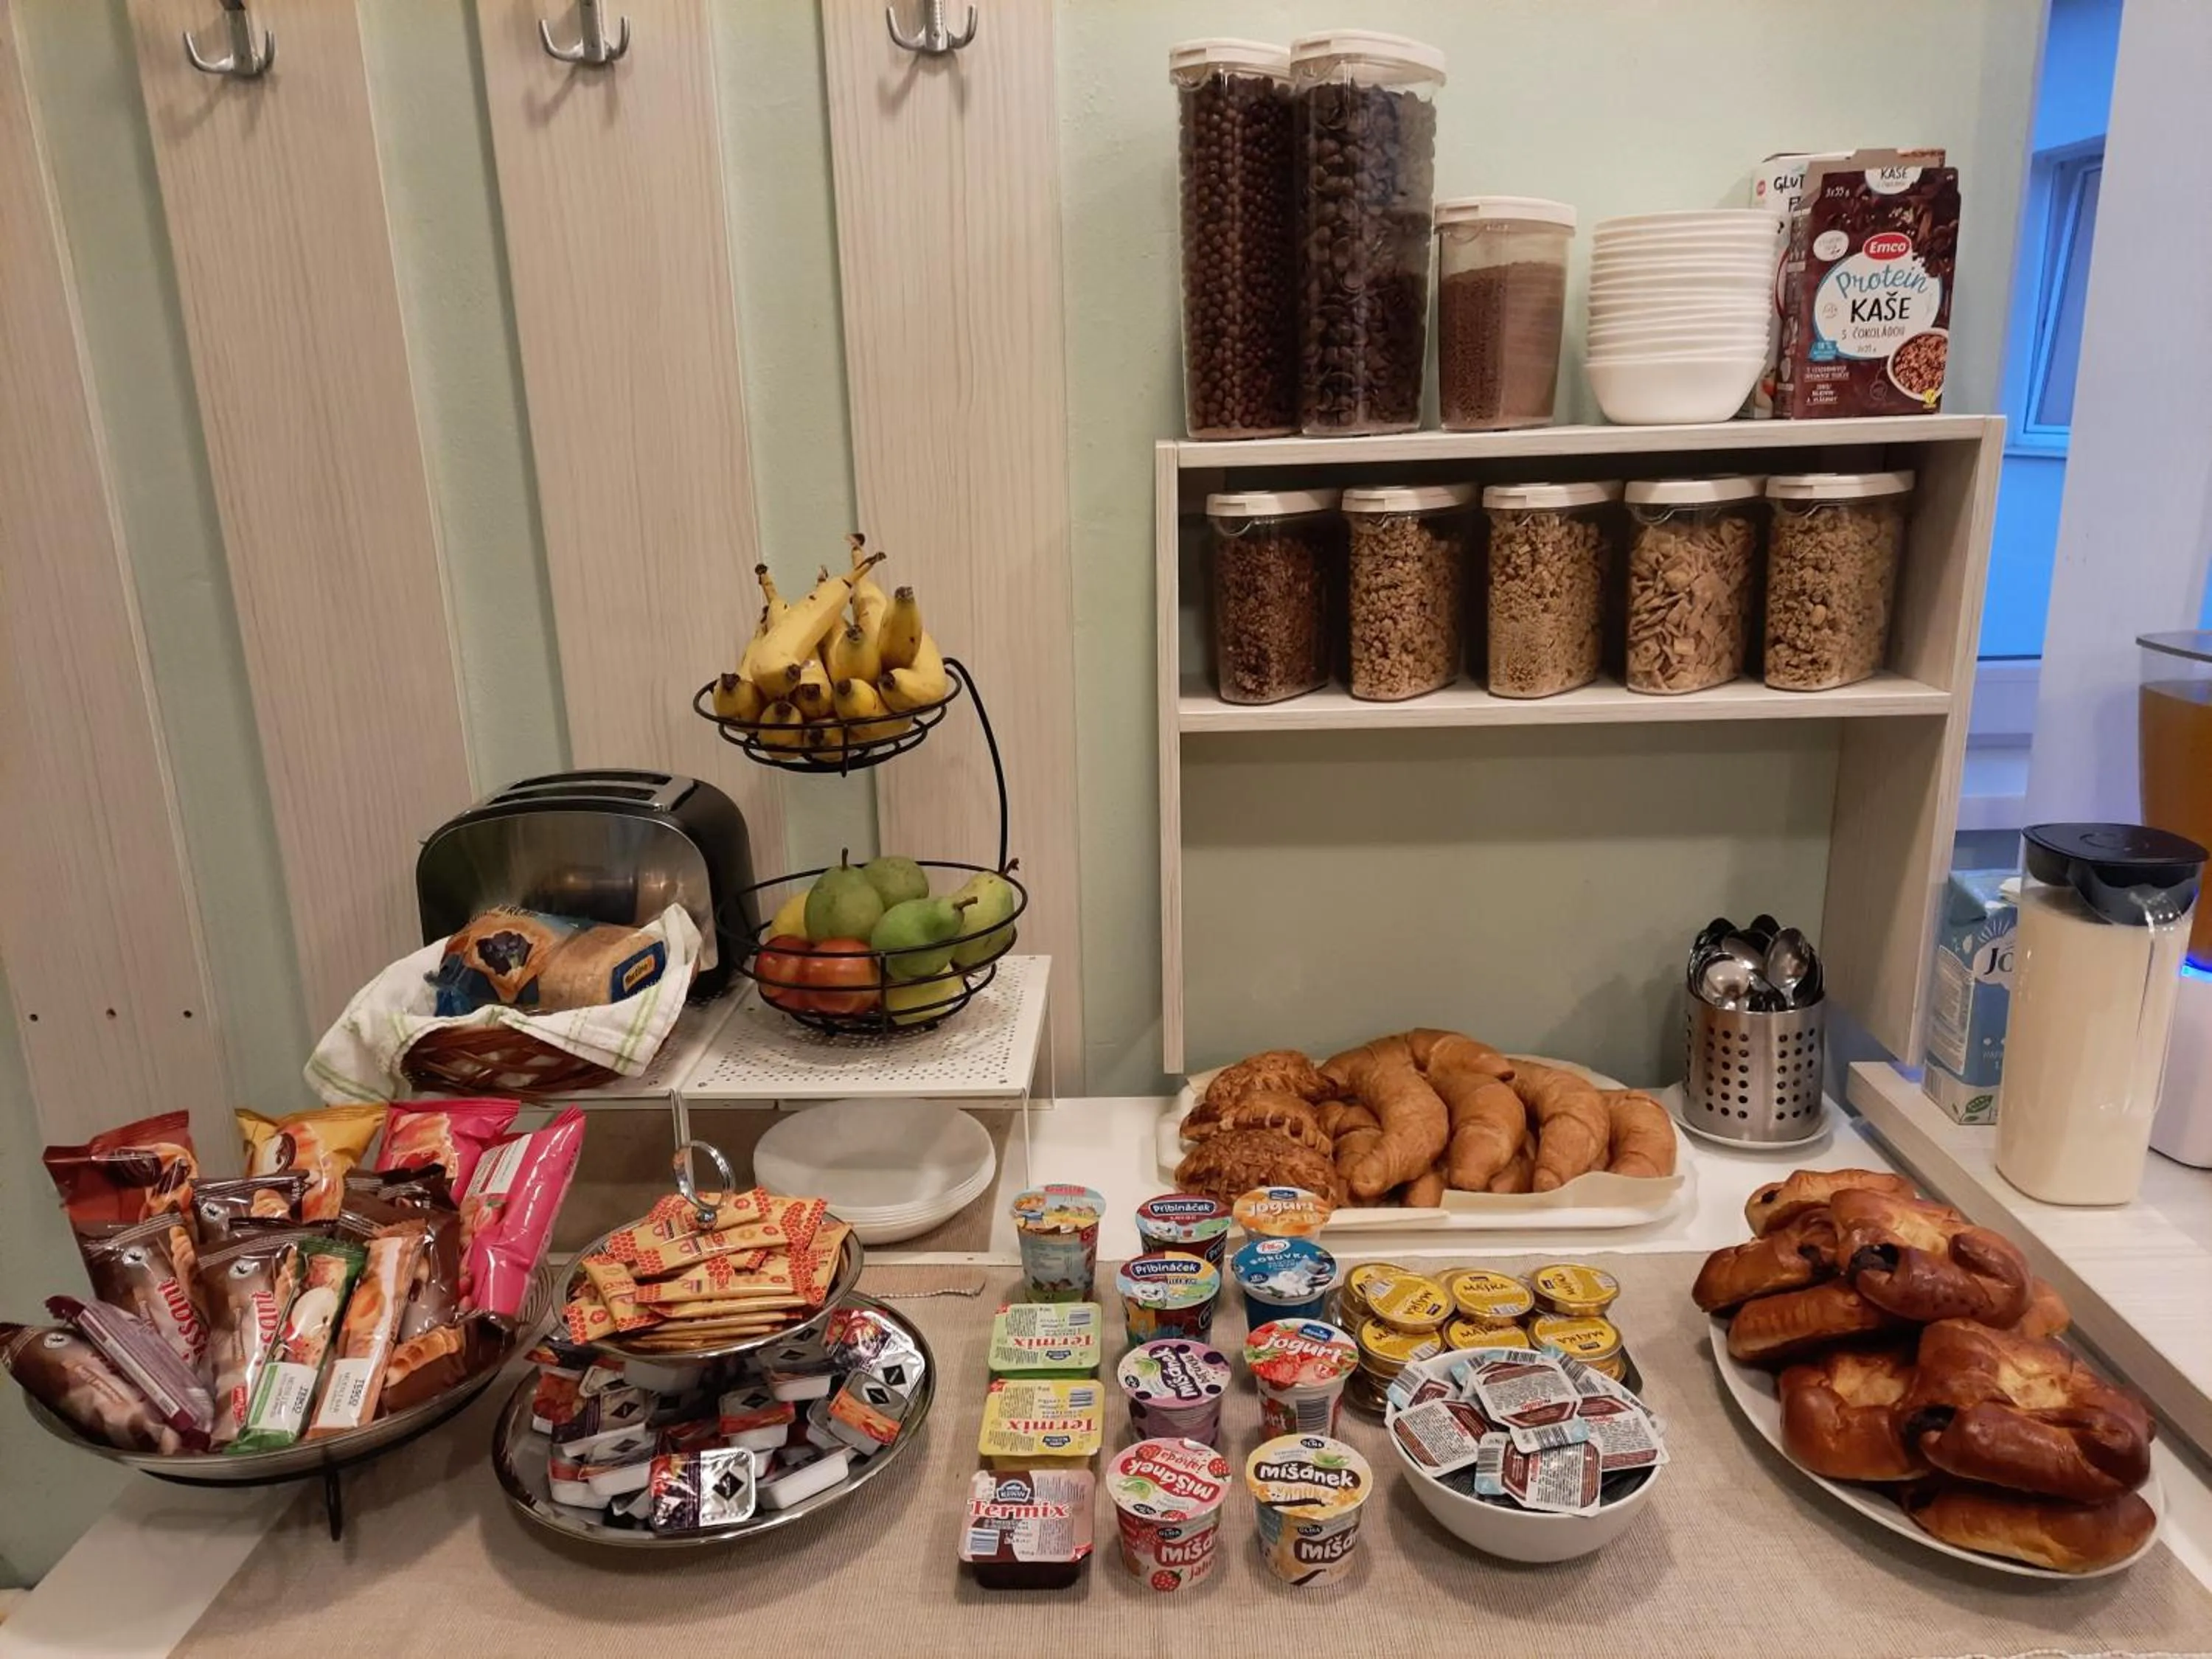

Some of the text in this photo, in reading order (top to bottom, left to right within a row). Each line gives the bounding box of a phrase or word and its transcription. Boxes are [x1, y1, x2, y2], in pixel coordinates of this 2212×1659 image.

[1869, 241, 1906, 254] Emco
[1836, 265, 1928, 299] Protein
[1851, 291, 1911, 323] KAŠE
[1135, 1262, 1197, 1276] Pribináček
[1014, 1335, 1094, 1350] Termix
[1009, 1418, 1097, 1434] Termix
[968, 1499, 1069, 1518] Termix
